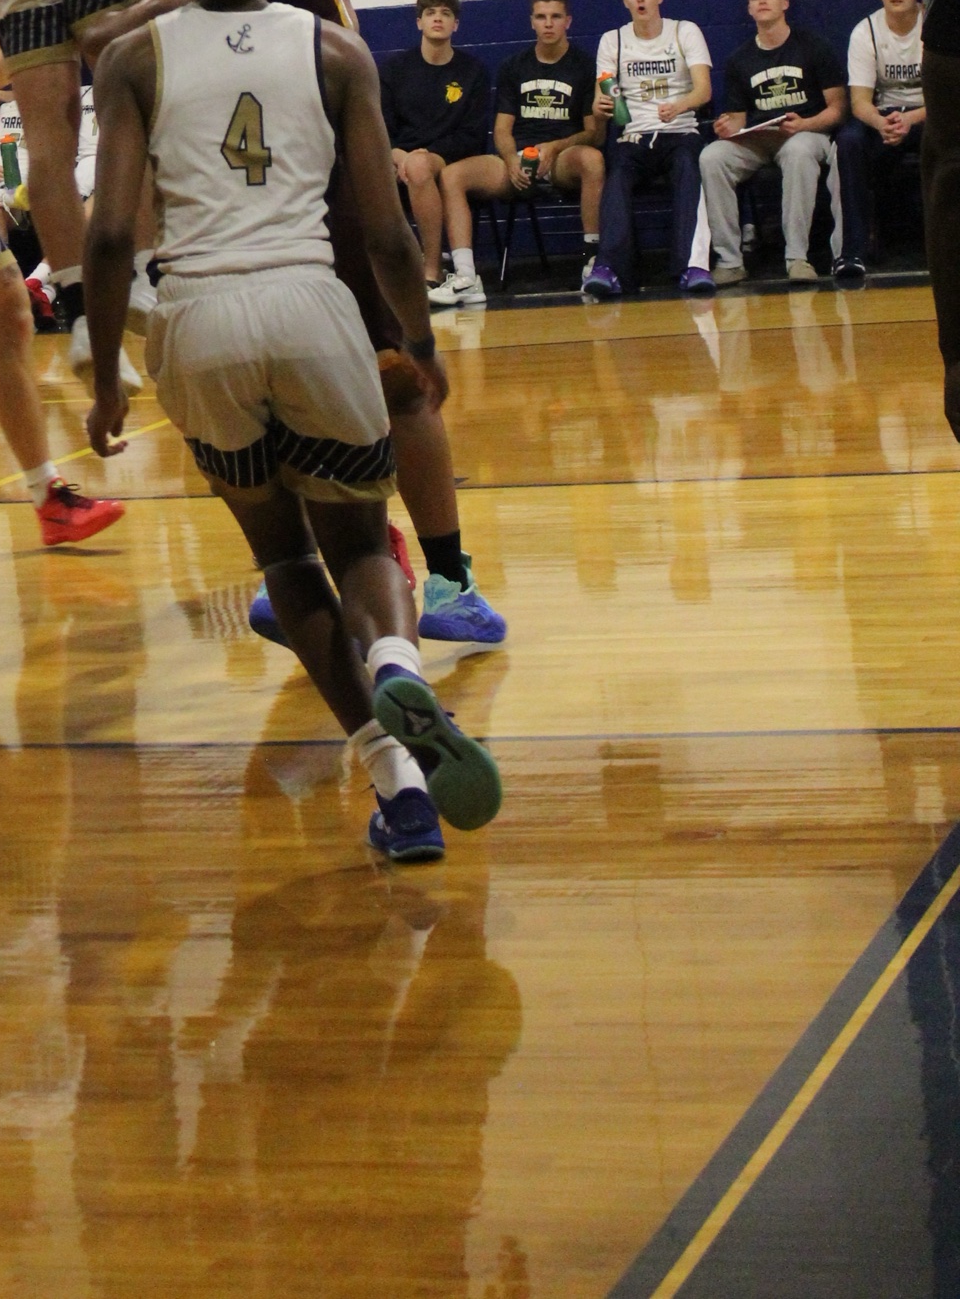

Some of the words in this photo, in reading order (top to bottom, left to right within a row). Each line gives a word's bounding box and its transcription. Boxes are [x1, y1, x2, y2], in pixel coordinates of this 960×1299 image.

[627, 58, 676, 77] FARRAGUT
[885, 63, 922, 80] FARRAG
[220, 91, 272, 186] 4
